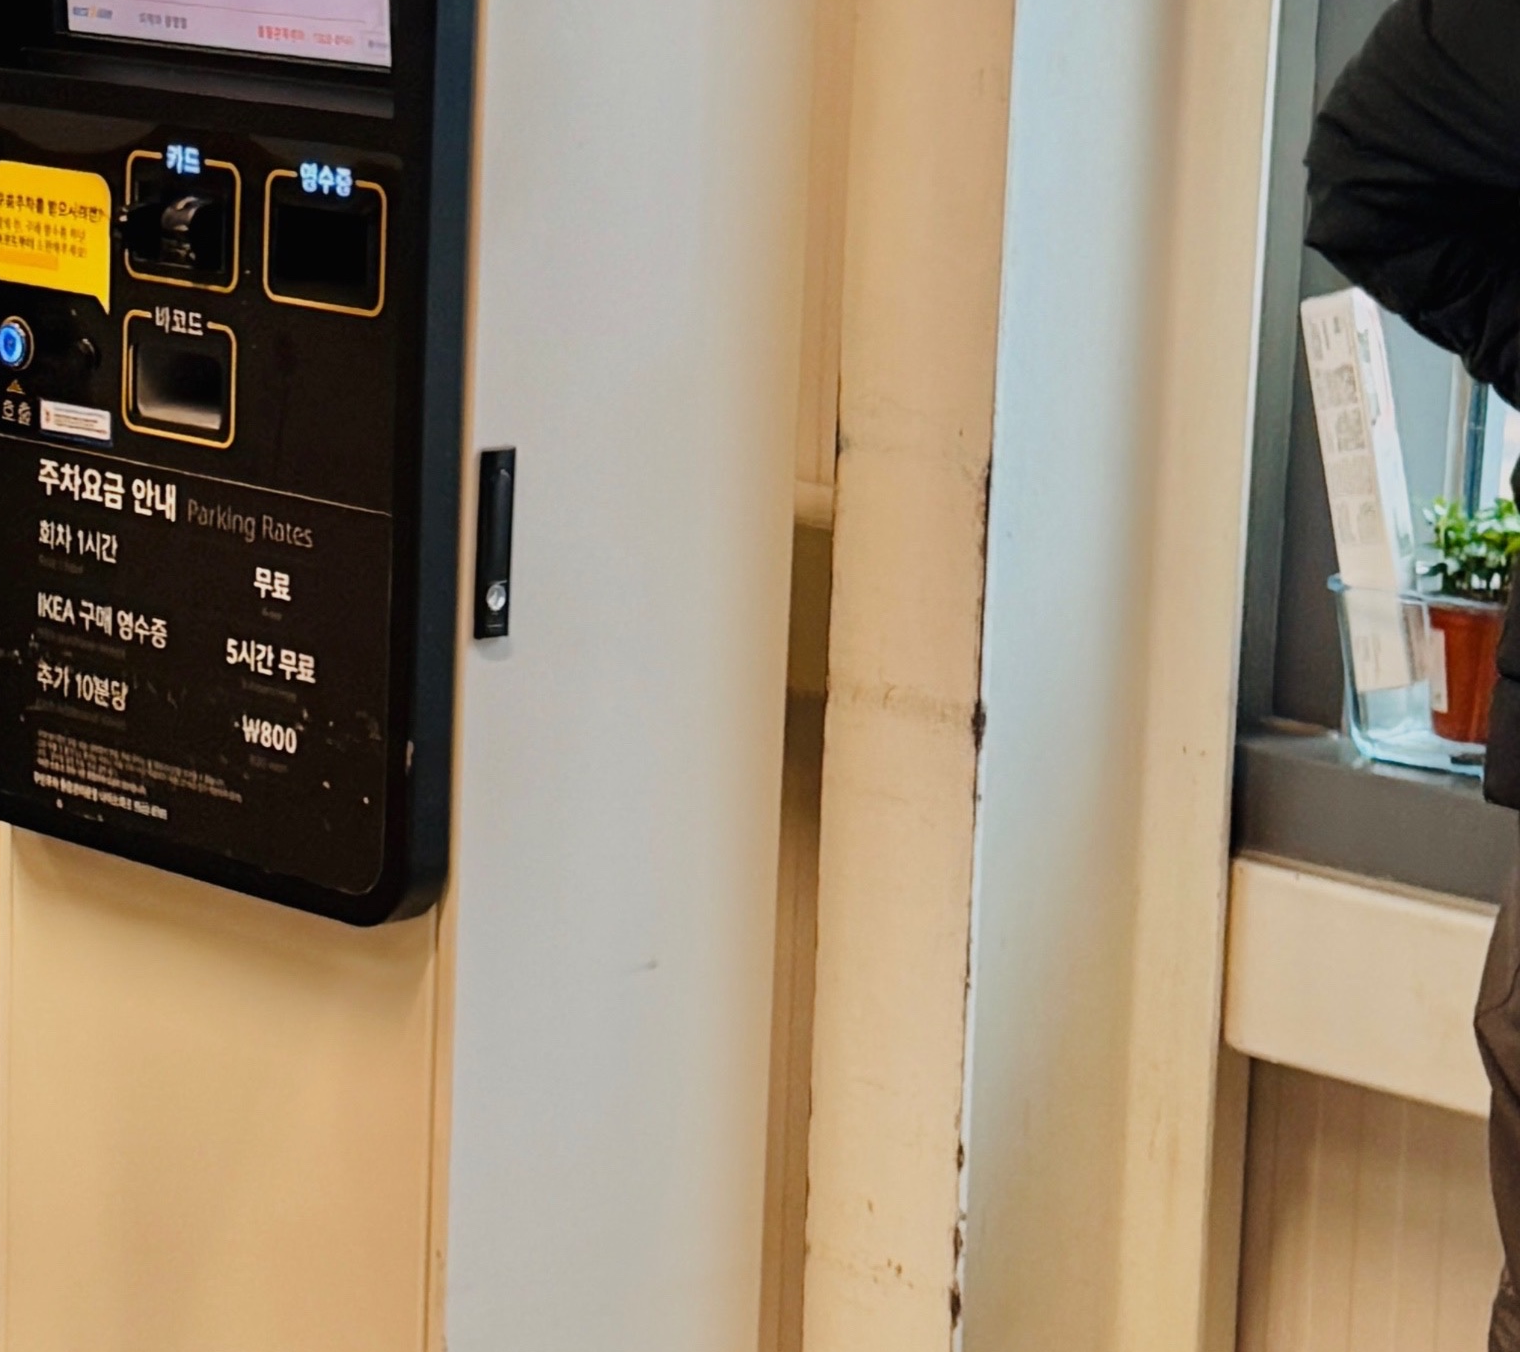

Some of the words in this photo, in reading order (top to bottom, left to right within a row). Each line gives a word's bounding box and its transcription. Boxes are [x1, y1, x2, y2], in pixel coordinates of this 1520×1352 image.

[166, 145, 200, 174] 카드
[299, 162, 352, 197] 영수증
[154, 307, 203, 335] 바코드
[38, 459, 125, 510] 주차요금
[132, 479, 176, 522] 안내
[188, 499, 255, 542] Parking
[263, 513, 313, 548] Rates
[38, 520, 72, 554] 회차
[78, 527, 118, 564] 1시간
[253, 566, 291, 601] 무료
[38, 592, 75, 625] IKEA
[79, 600, 112, 636] 구매
[117, 610, 168, 648] 영수증
[226, 638, 273, 676] 5시간
[278, 649, 316, 684] 무료
[37, 660, 69, 697] 추가
[76, 671, 129, 711] 10분당
[242, 714, 297, 754] ₩800
